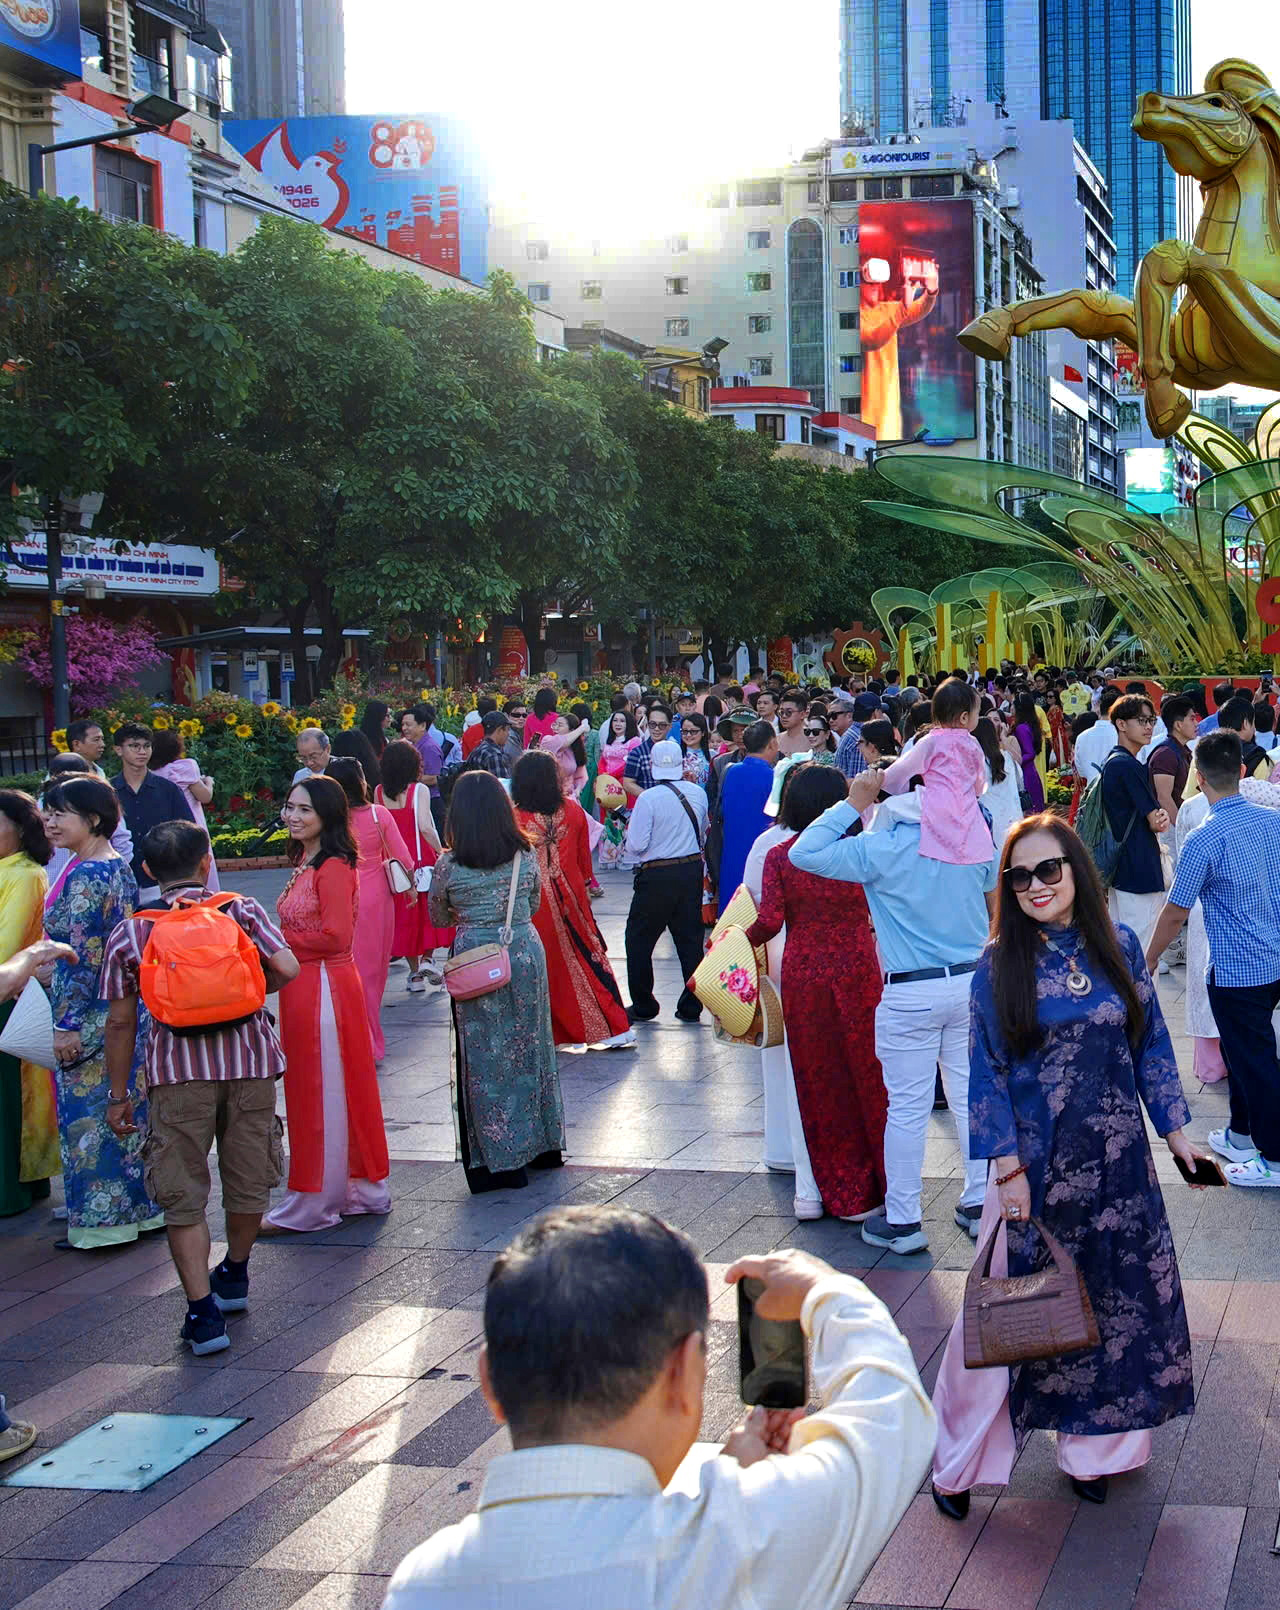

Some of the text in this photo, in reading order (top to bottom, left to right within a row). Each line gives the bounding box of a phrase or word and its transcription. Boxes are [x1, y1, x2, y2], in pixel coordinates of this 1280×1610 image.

[862, 152, 930, 163] SAIGONTOURIST
[288, 198, 319, 208] 026
[9, 568, 36, 576] TRADE
